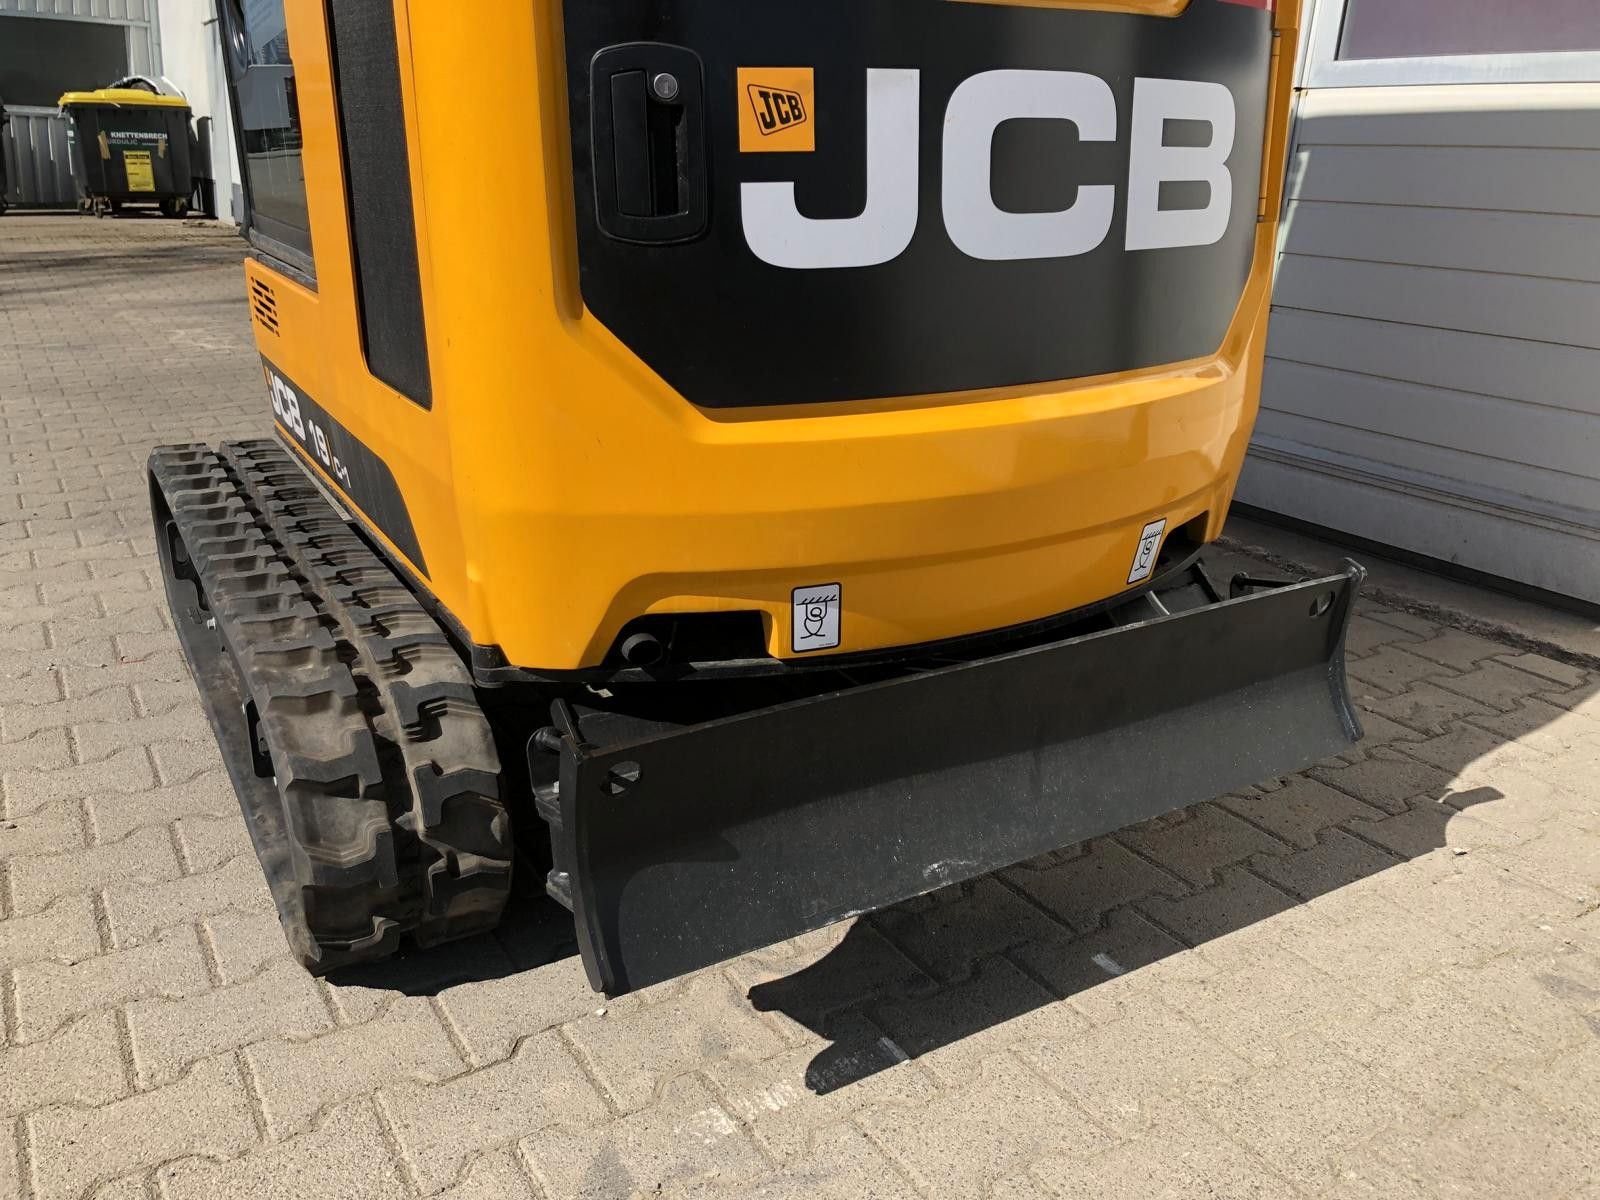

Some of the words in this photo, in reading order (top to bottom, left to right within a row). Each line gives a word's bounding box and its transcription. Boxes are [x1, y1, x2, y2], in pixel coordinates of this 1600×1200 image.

[758, 90, 802, 129] JCB
[741, 68, 1235, 269] JCB
[267, 370, 306, 441] JCB
